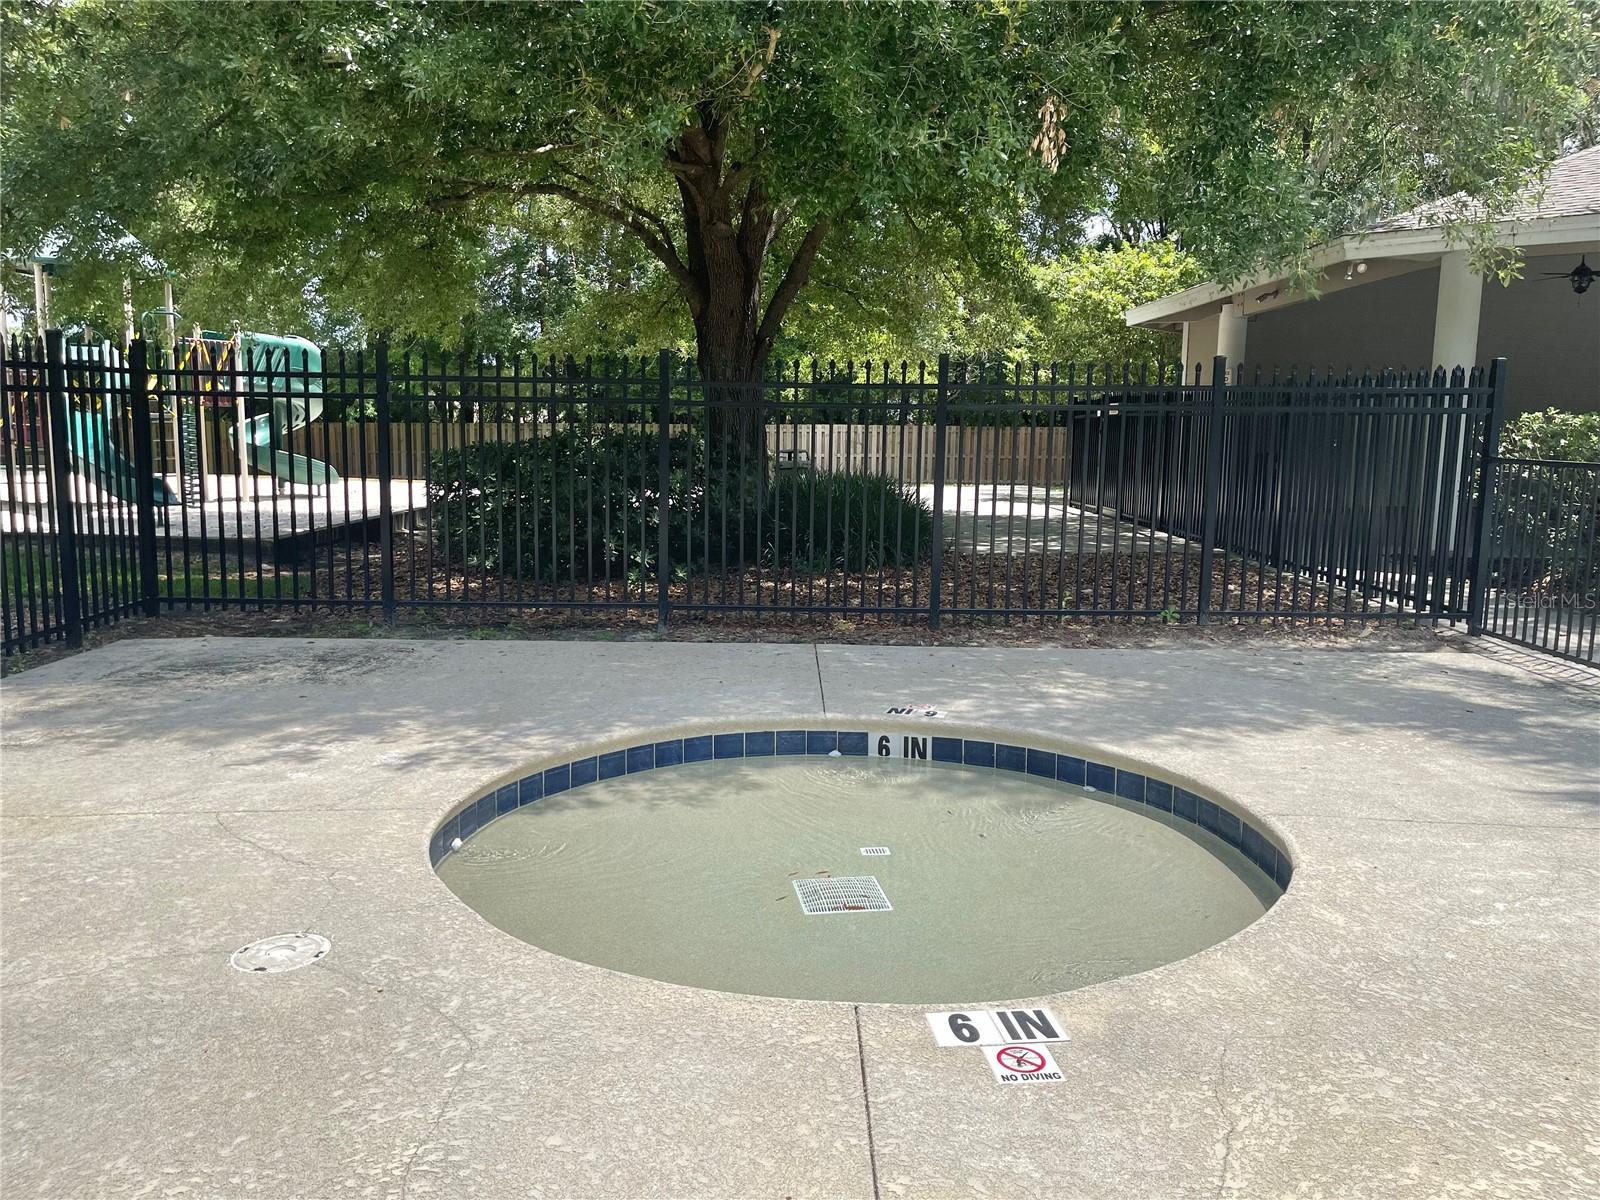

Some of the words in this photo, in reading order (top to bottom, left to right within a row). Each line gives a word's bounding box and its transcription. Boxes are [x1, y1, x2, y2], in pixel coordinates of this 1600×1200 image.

[886, 707, 914, 715] IN
[877, 735, 891, 757] 6
[903, 736, 928, 760] IN
[948, 1013, 981, 1043] 6
[996, 1009, 1060, 1041] IN
[1000, 1074, 1019, 1082] NO
[1020, 1072, 1062, 1081] DIVING
